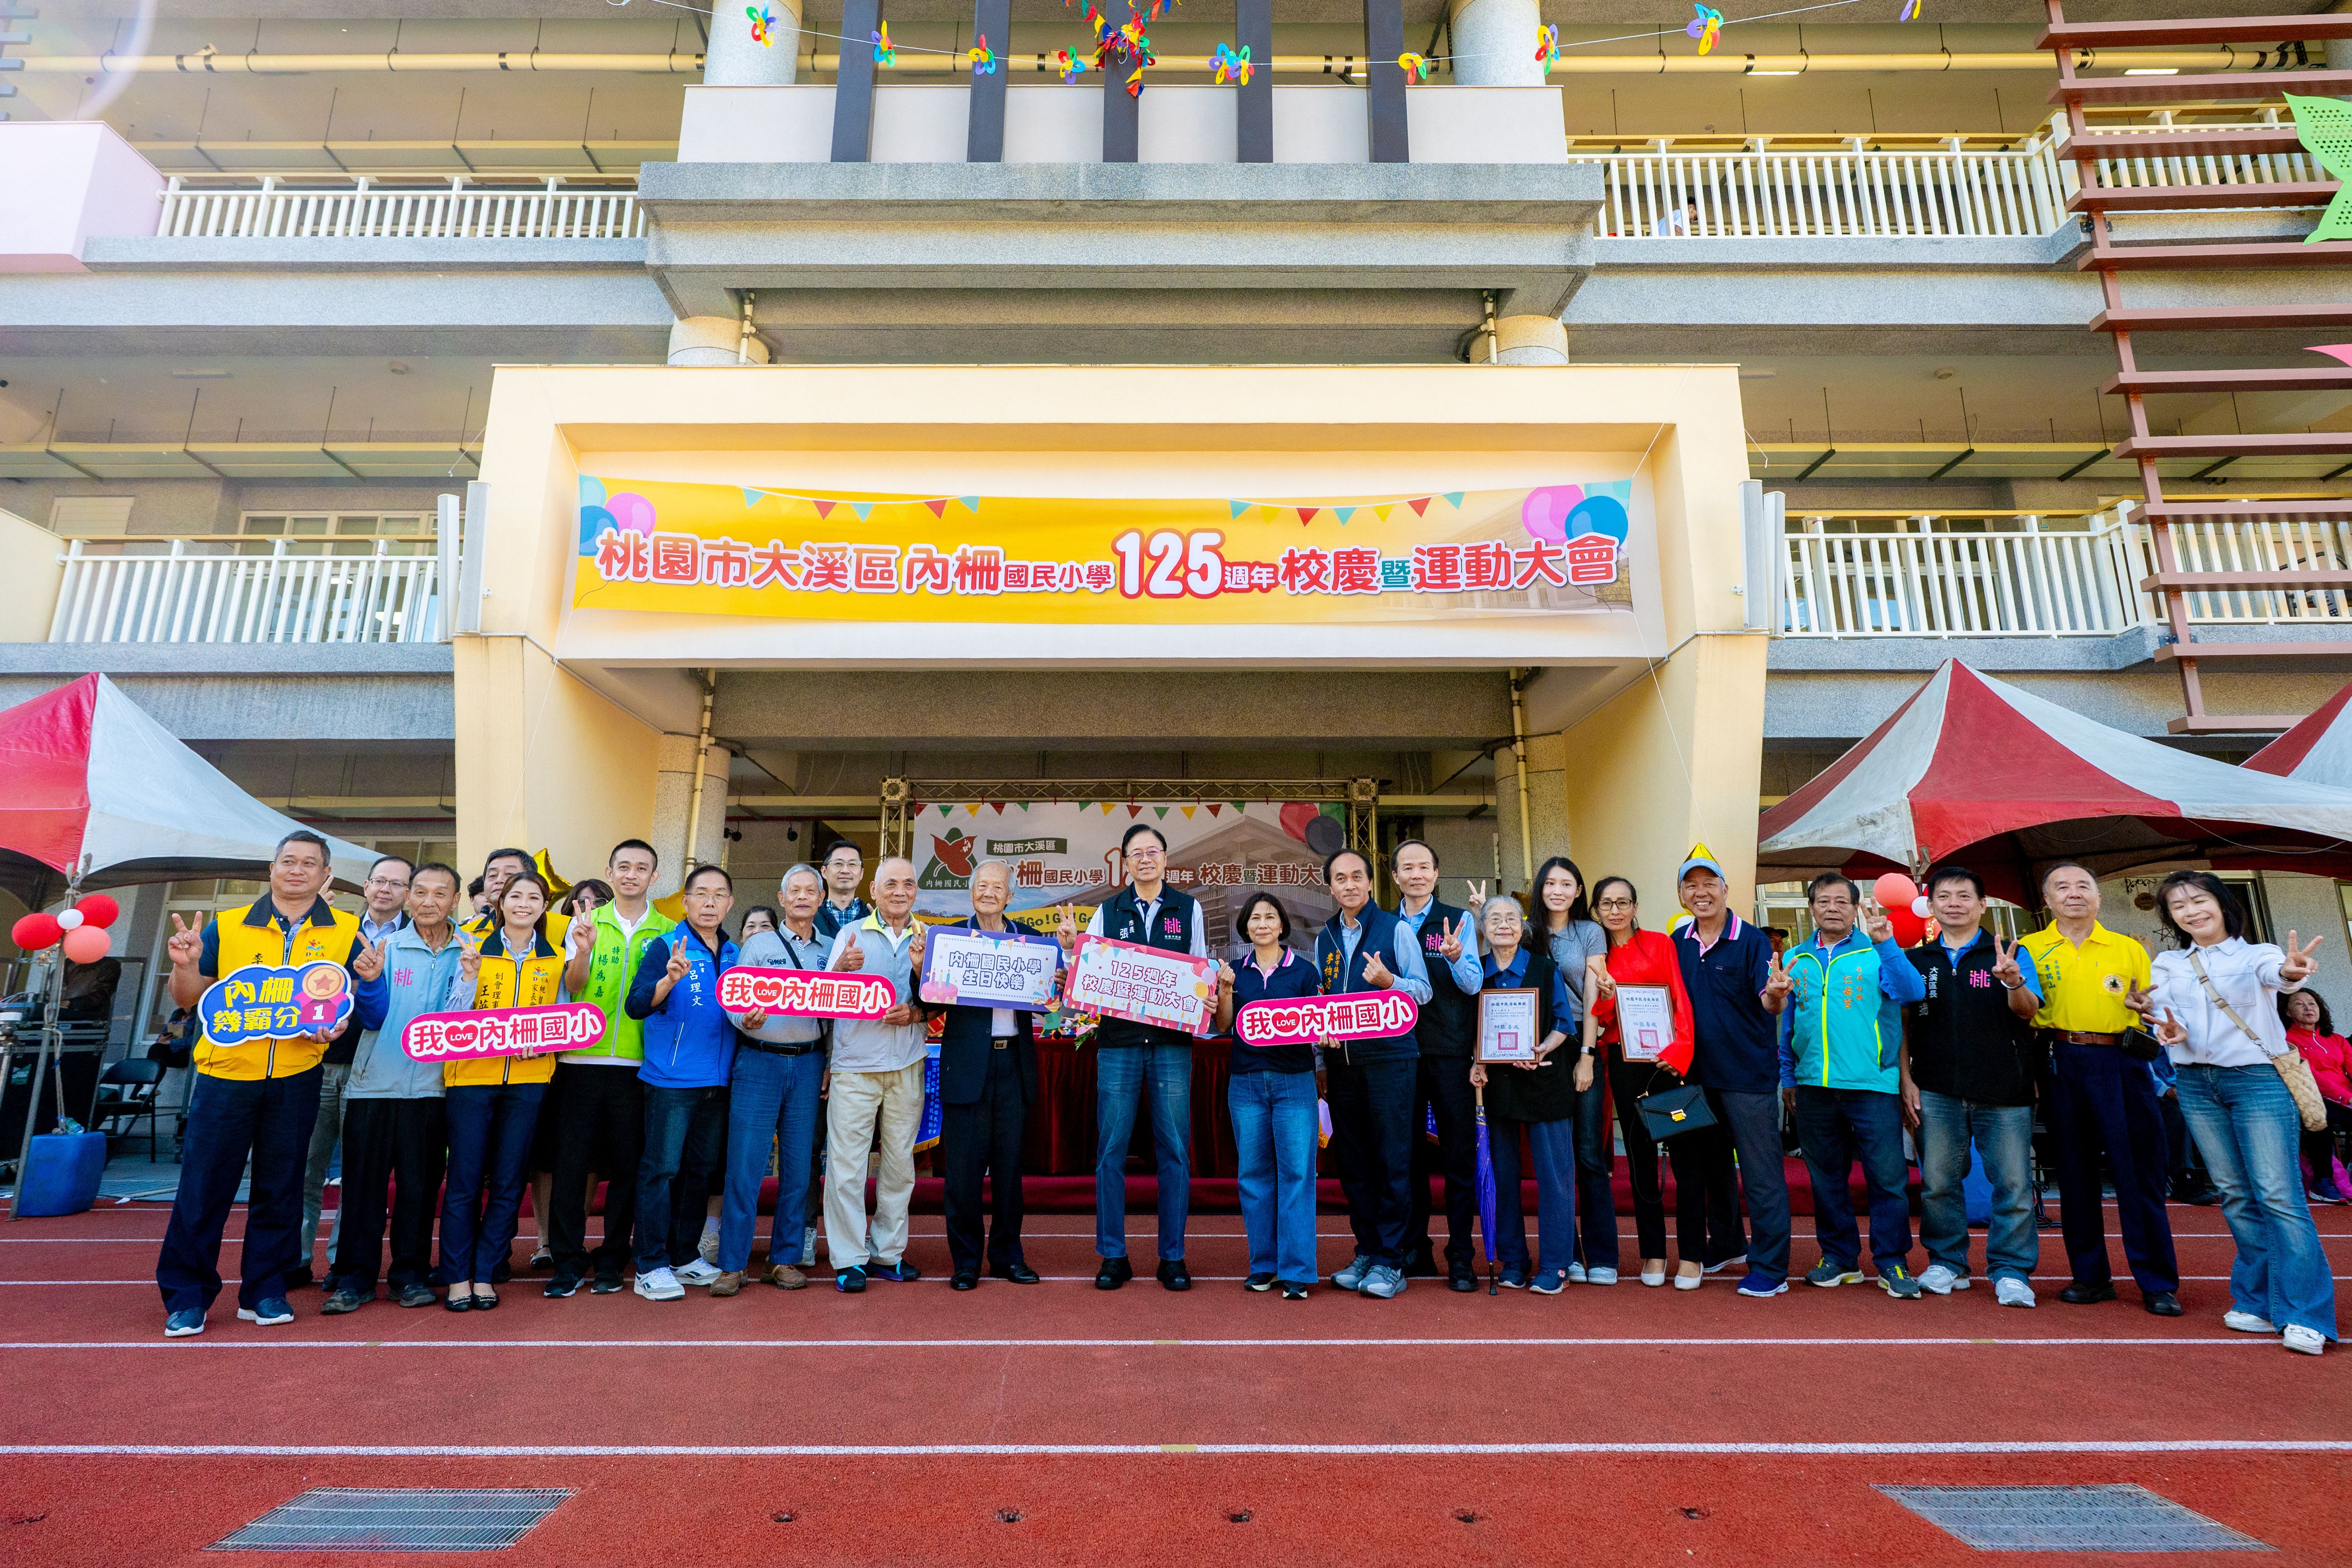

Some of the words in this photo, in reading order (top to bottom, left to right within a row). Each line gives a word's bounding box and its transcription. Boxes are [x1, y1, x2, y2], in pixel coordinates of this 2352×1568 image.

[993, 839, 1055, 853] 桃園市大溪區
[1120, 928, 1129, 939] 張
[1129, 920, 1135, 933] 市長
[611, 946, 620, 964] 特助
[949, 951, 1042, 974] 內柵國民小學
[594, 954, 608, 998] 楊為嘉
[963, 970, 1024, 991] 生日快樂
[1111, 960, 1177, 987] 125週年
[1929, 966, 1938, 998] 大溪區長
[224, 977, 294, 1008] 內柵
[689, 970, 703, 1006] 呂理文
[726, 977, 751, 1004] 我
[782, 979, 888, 1011] 內柵國小
[1082, 974, 1198, 1013] 校慶暨運動大會
[213, 1006, 301, 1033] 幾霸分
[312, 1004, 324, 1020] 1
[1246, 1012, 1272, 1035] 我
[1302, 1000, 1409, 1033] 內柵國小
[414, 1025, 444, 1053] 我
[480, 1013, 601, 1047] 內柵國小
